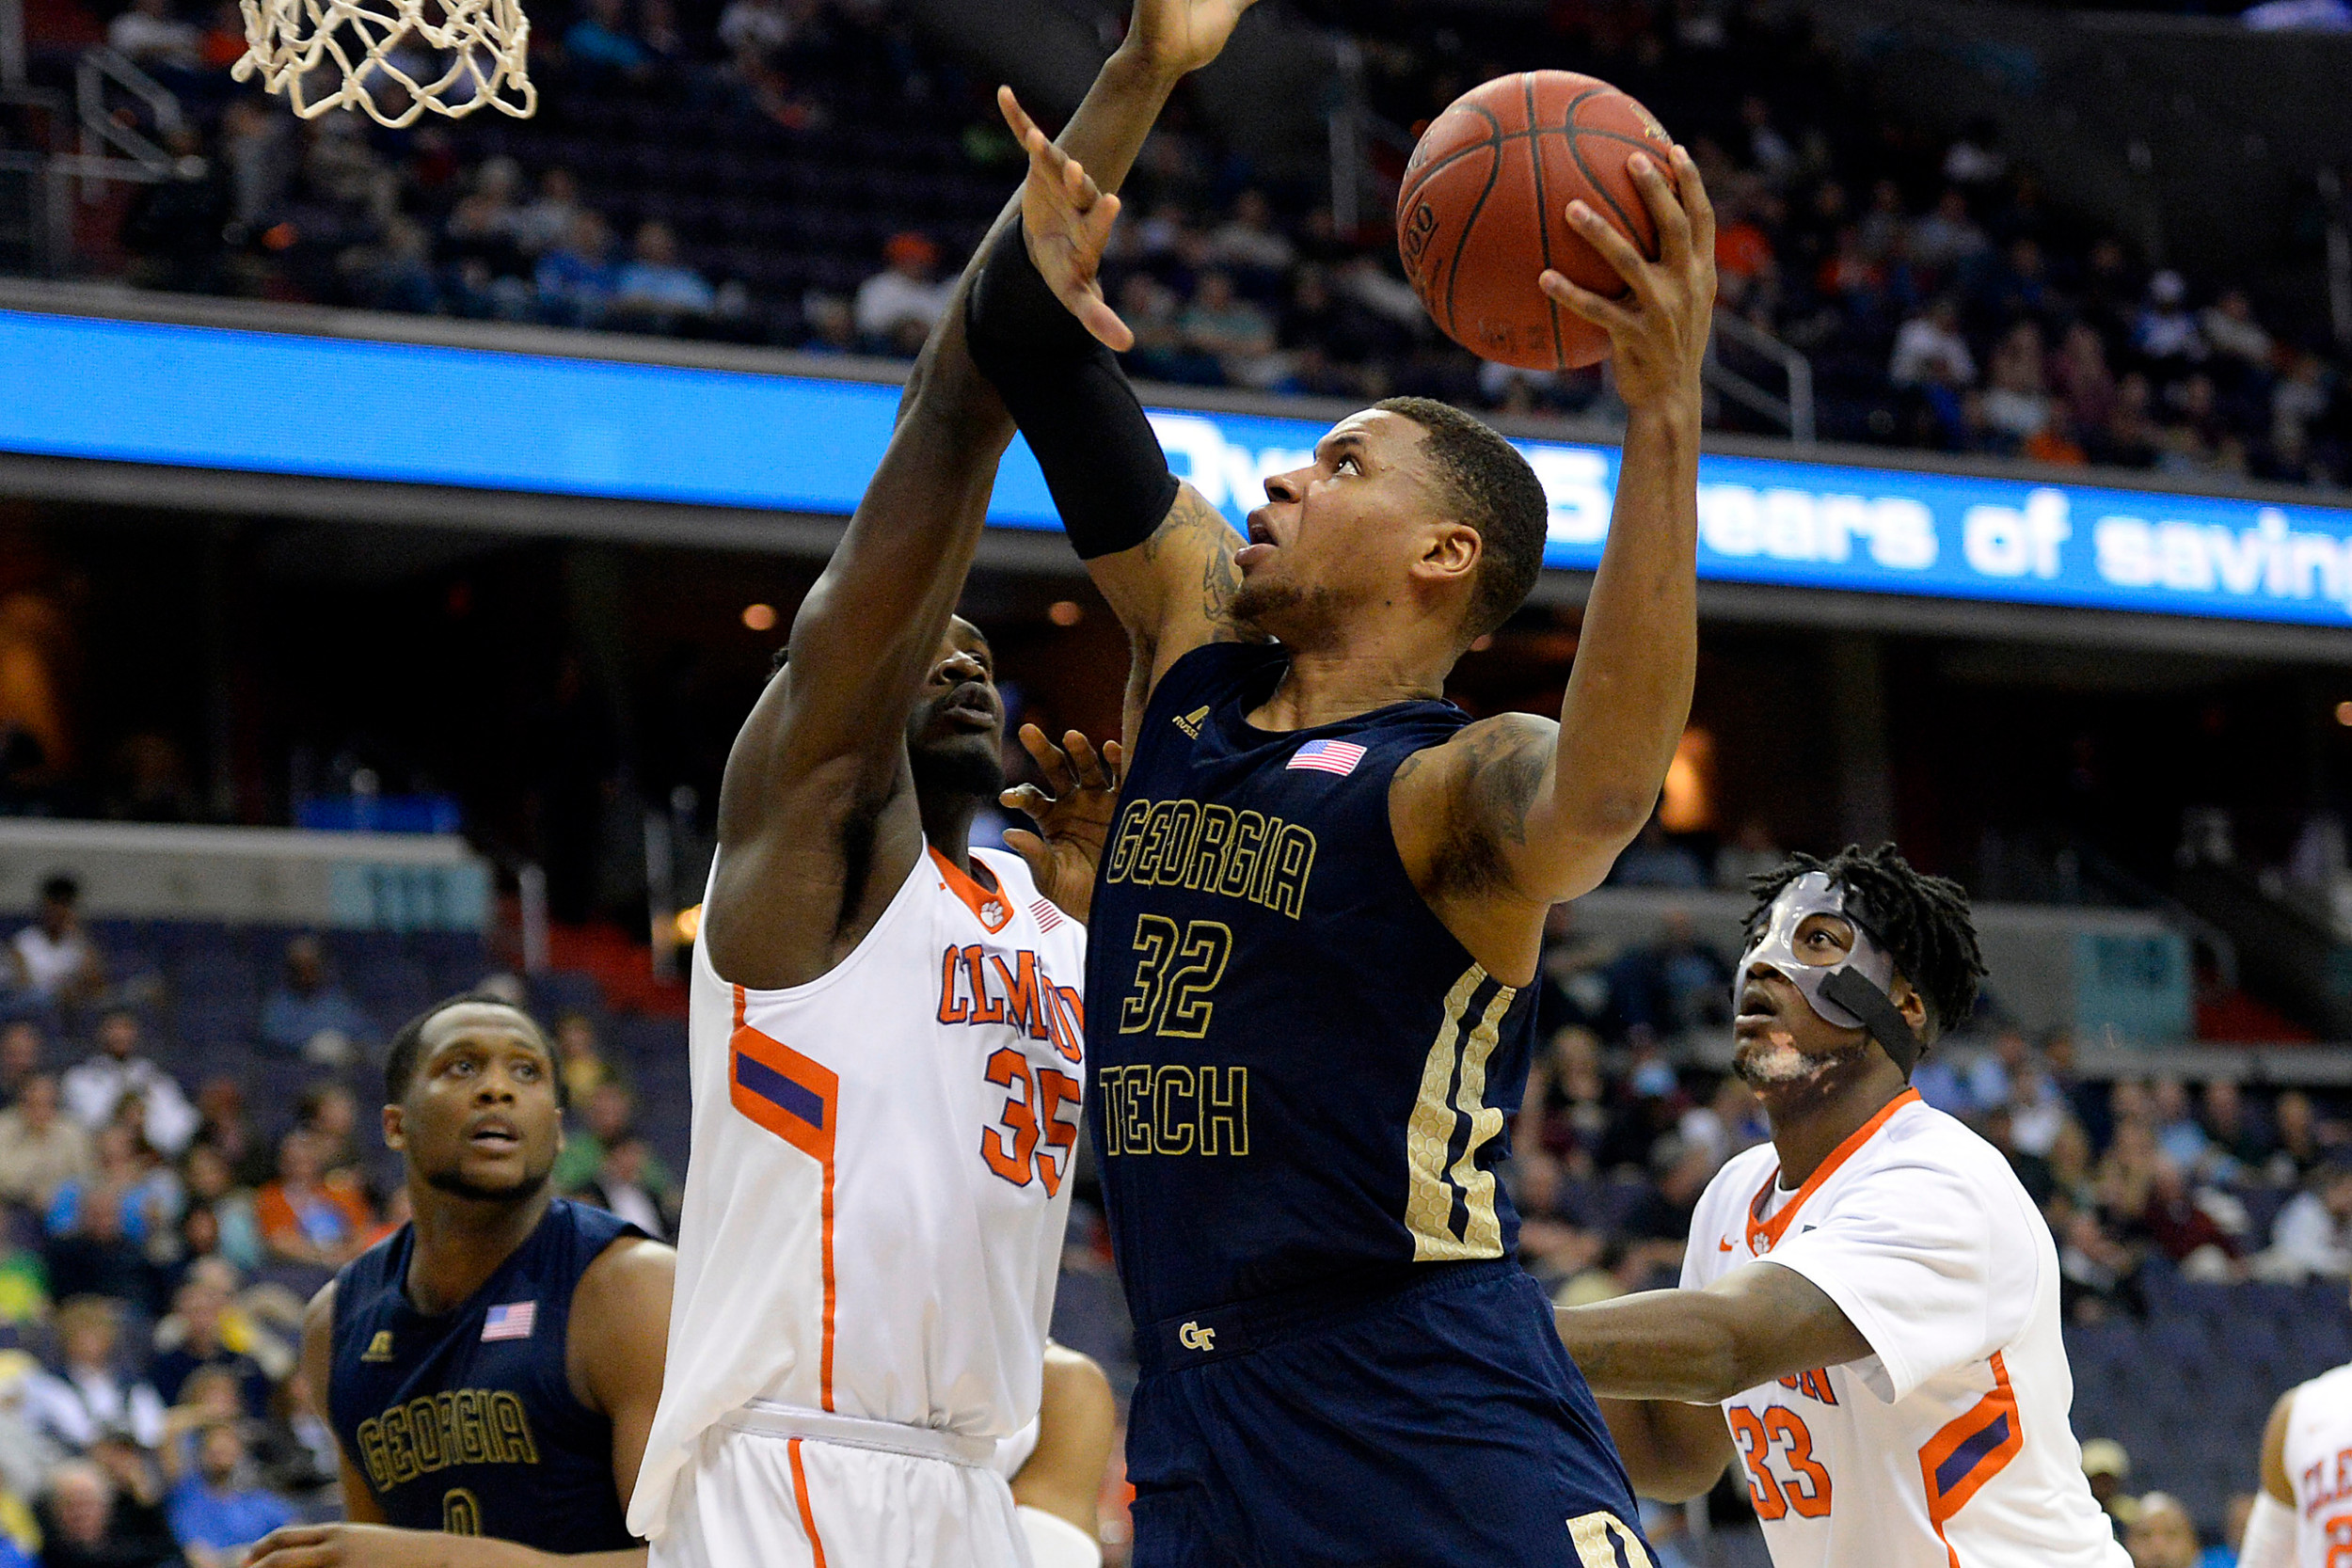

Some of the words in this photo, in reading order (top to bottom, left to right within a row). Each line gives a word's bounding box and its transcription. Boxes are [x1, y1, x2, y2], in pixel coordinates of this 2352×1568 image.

[1696, 483, 1939, 569] ears
[1963, 487, 2070, 580] of
[2092, 515, 2352, 616] savin
[1106, 799, 1317, 921] GEORGIA
[1119, 913, 1233, 1039] 32
[979, 1046, 1082, 1199] 35
[1099, 1064, 1249, 1156] TECH
[1179, 1321, 1216, 1352] GT
[357, 1387, 540, 1493] GEORGIA
[1728, 1405, 1833, 1521] 33
